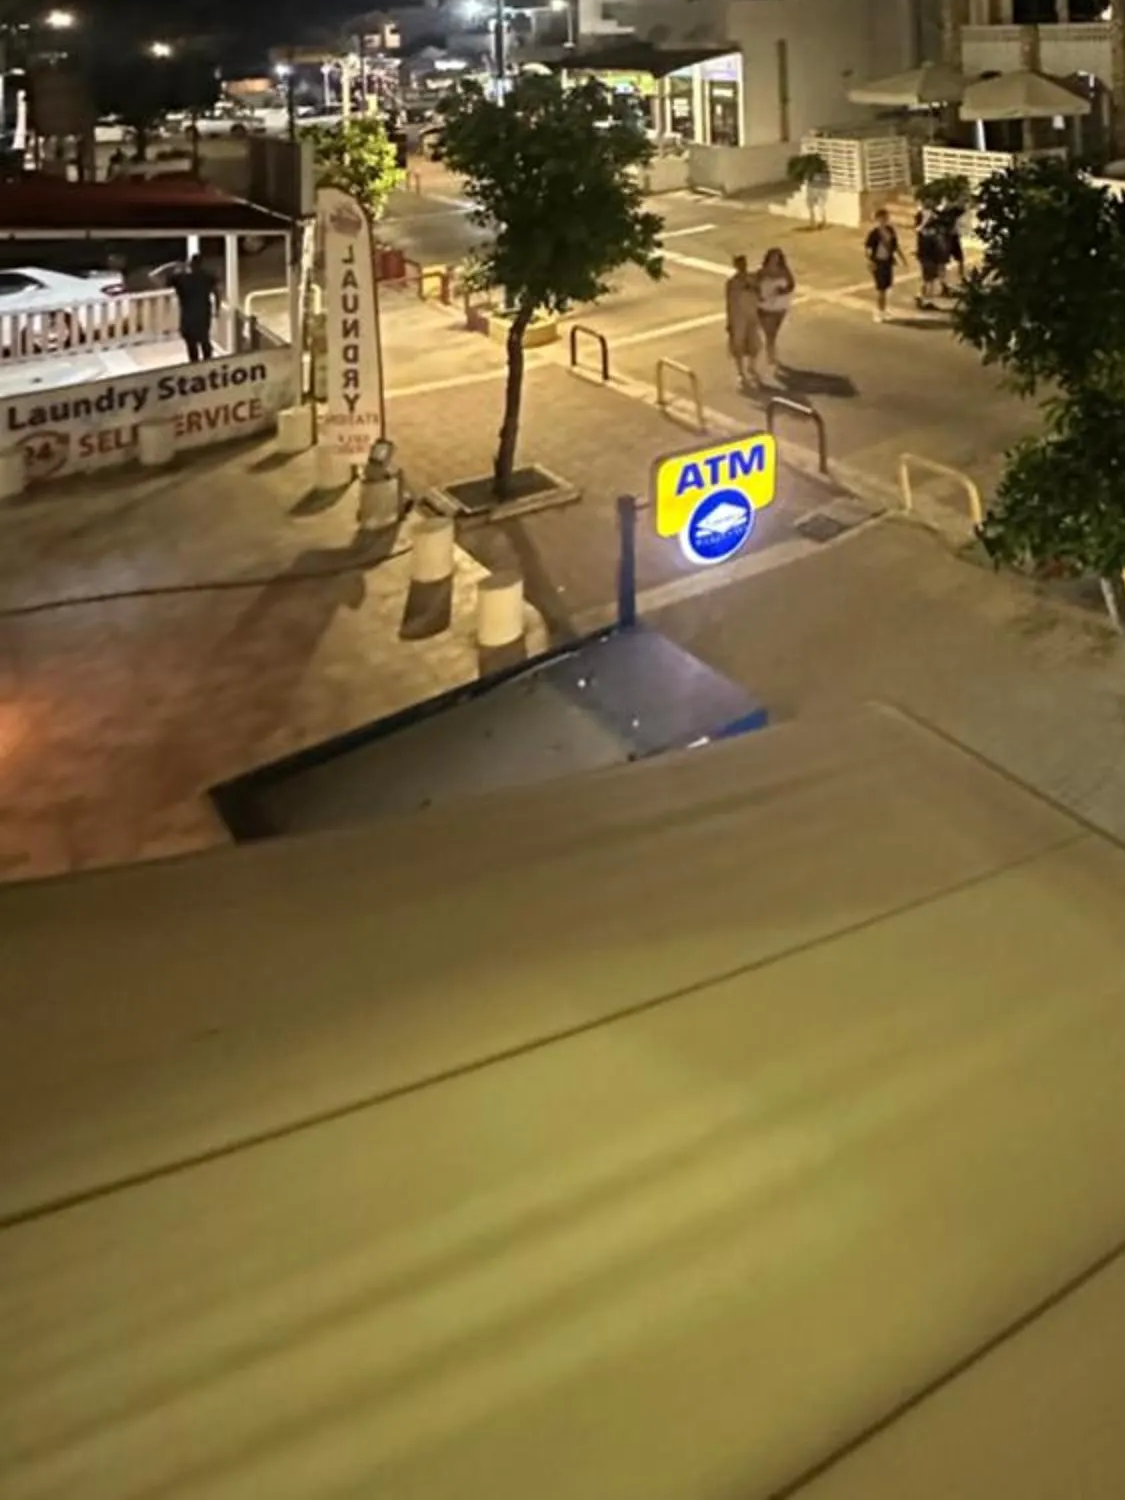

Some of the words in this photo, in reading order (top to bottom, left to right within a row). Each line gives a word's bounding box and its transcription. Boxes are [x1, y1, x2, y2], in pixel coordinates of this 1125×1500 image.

[8, 386, 150, 431] Laundry
[157, 363, 267, 401] Station
[675, 444, 765, 496] ATM
